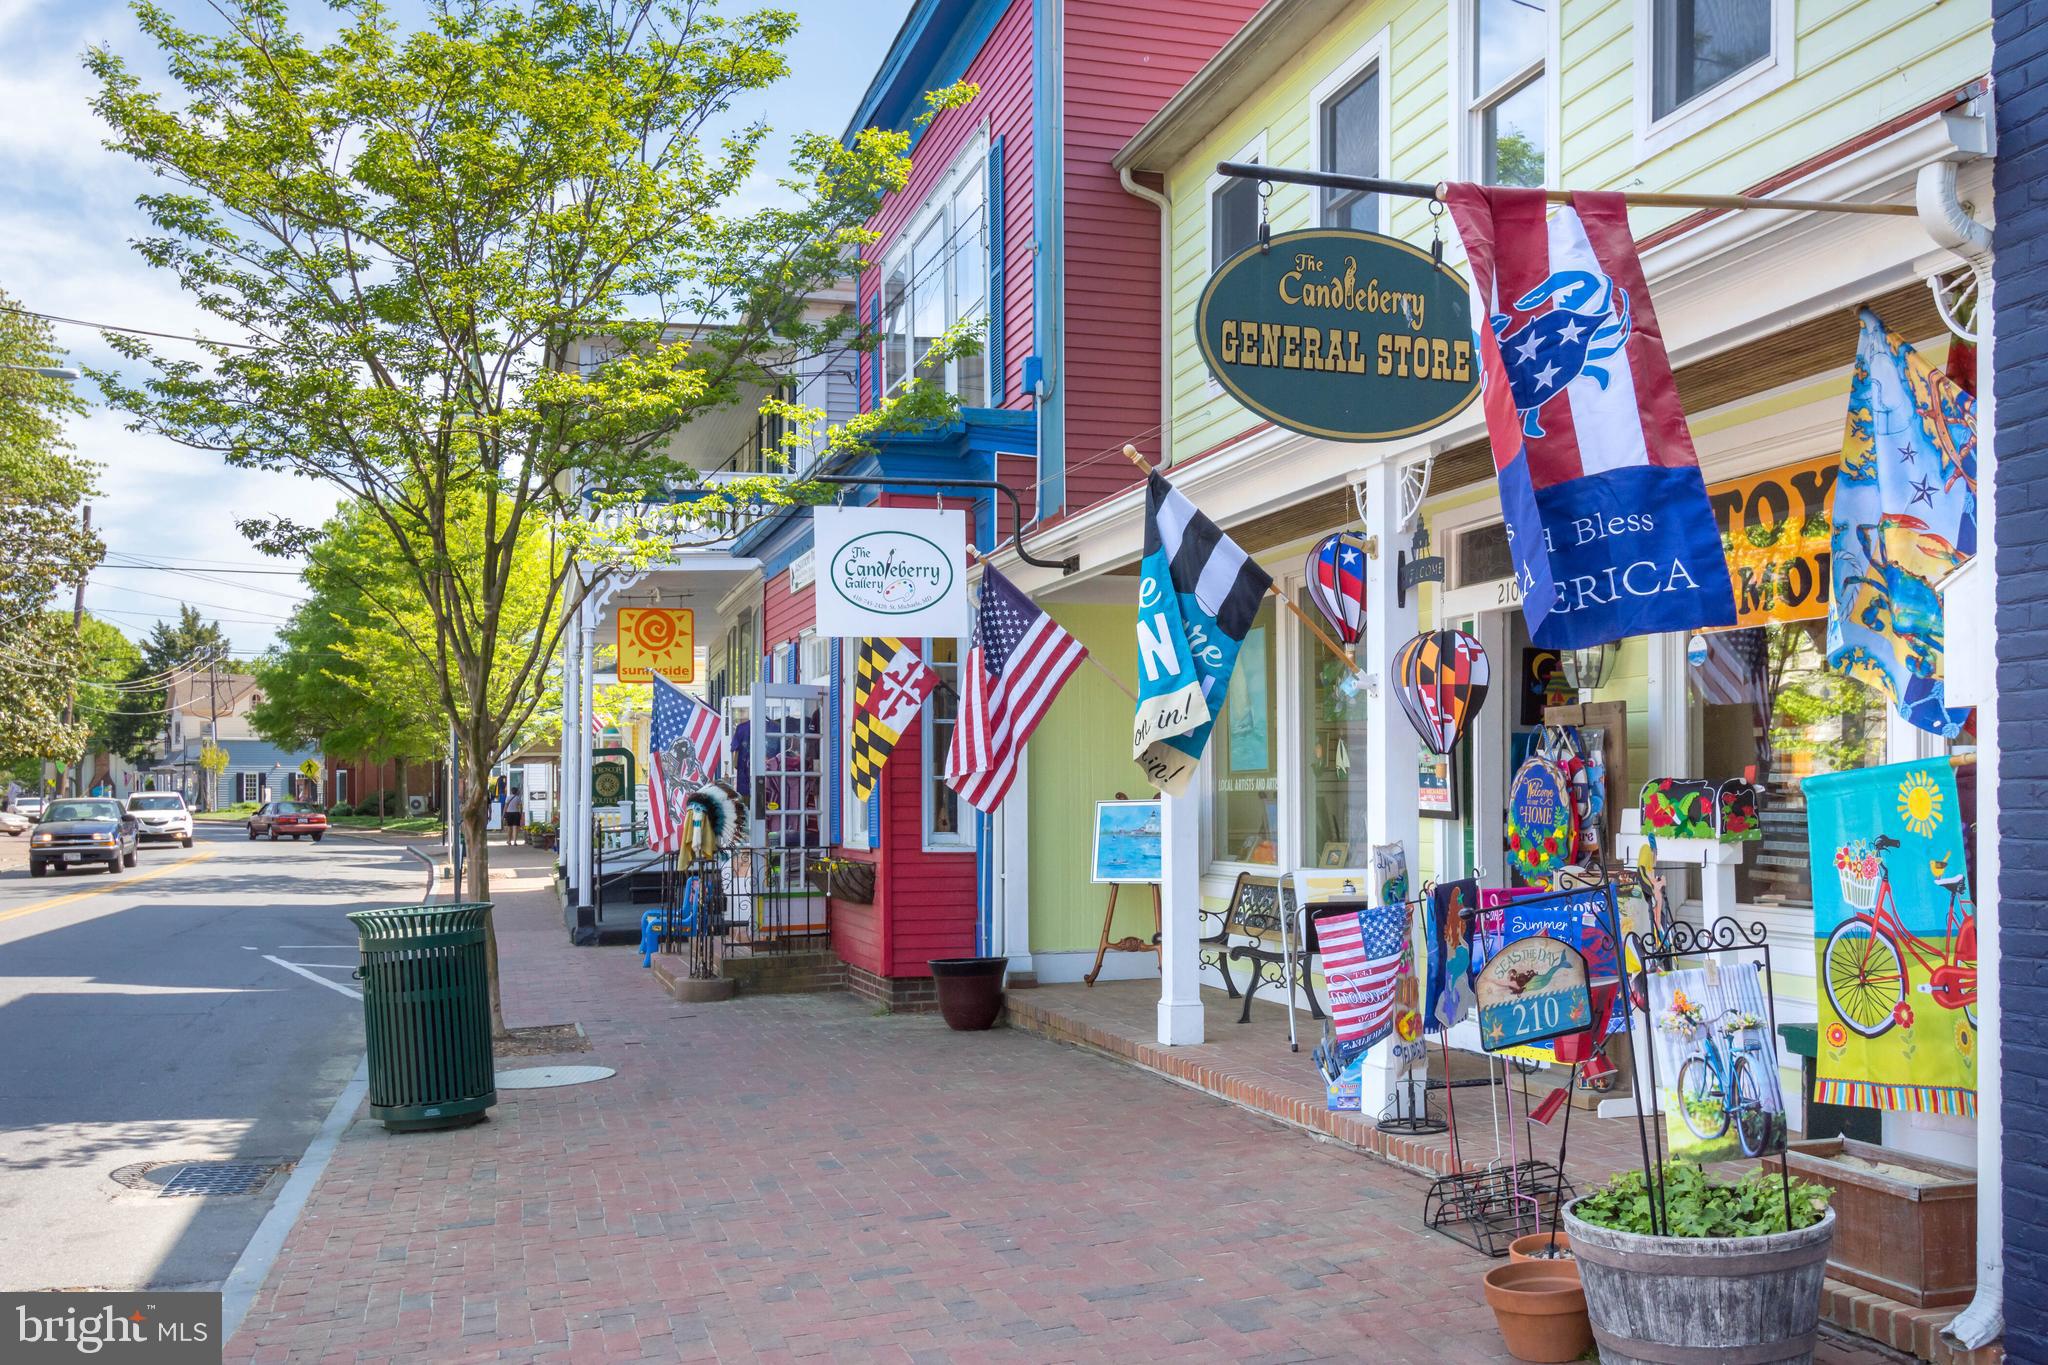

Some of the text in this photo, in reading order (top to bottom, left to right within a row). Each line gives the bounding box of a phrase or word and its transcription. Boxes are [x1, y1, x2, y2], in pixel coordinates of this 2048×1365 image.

[1294, 253, 1324, 272] The
[1278, 256, 1425, 331] Candleberry
[1221, 320, 1471, 383] GENERAL STORE
[1572, 512, 1655, 546] Bless
[844, 550, 940, 586] Candleberry
[851, 546, 871, 559] The
[845, 577, 884, 594] Gallery
[1498, 582, 1519, 605] 210
[1550, 557, 1700, 614] ERICA
[1157, 692, 1192, 730] in!
[1218, 777, 1233, 791] LOCAL
[1520, 806, 1553, 825] HOME
[1512, 916, 1568, 934] Summer
[1495, 947, 1560, 979] SEAS THE DAY
[1512, 996, 1560, 1036] 210
